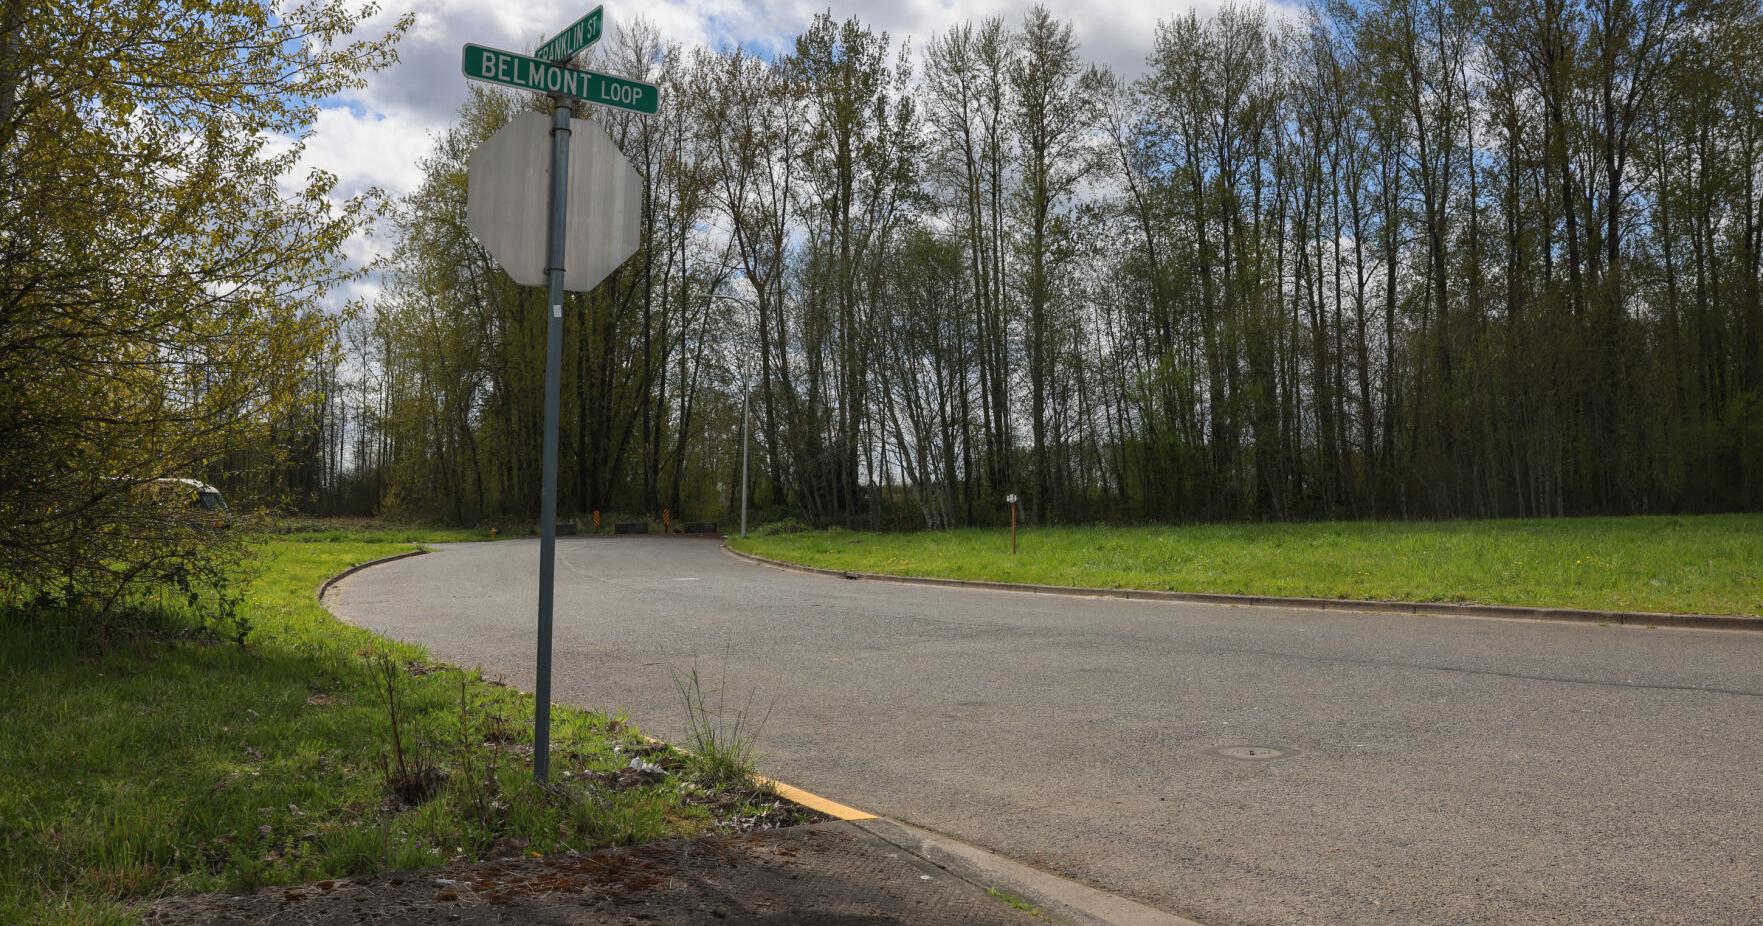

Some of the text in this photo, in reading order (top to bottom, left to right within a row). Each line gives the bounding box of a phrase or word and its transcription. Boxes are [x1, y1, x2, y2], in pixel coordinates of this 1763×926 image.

[587, 15, 598, 38] ST
[481, 51, 643, 106] BELMONT LOOP
